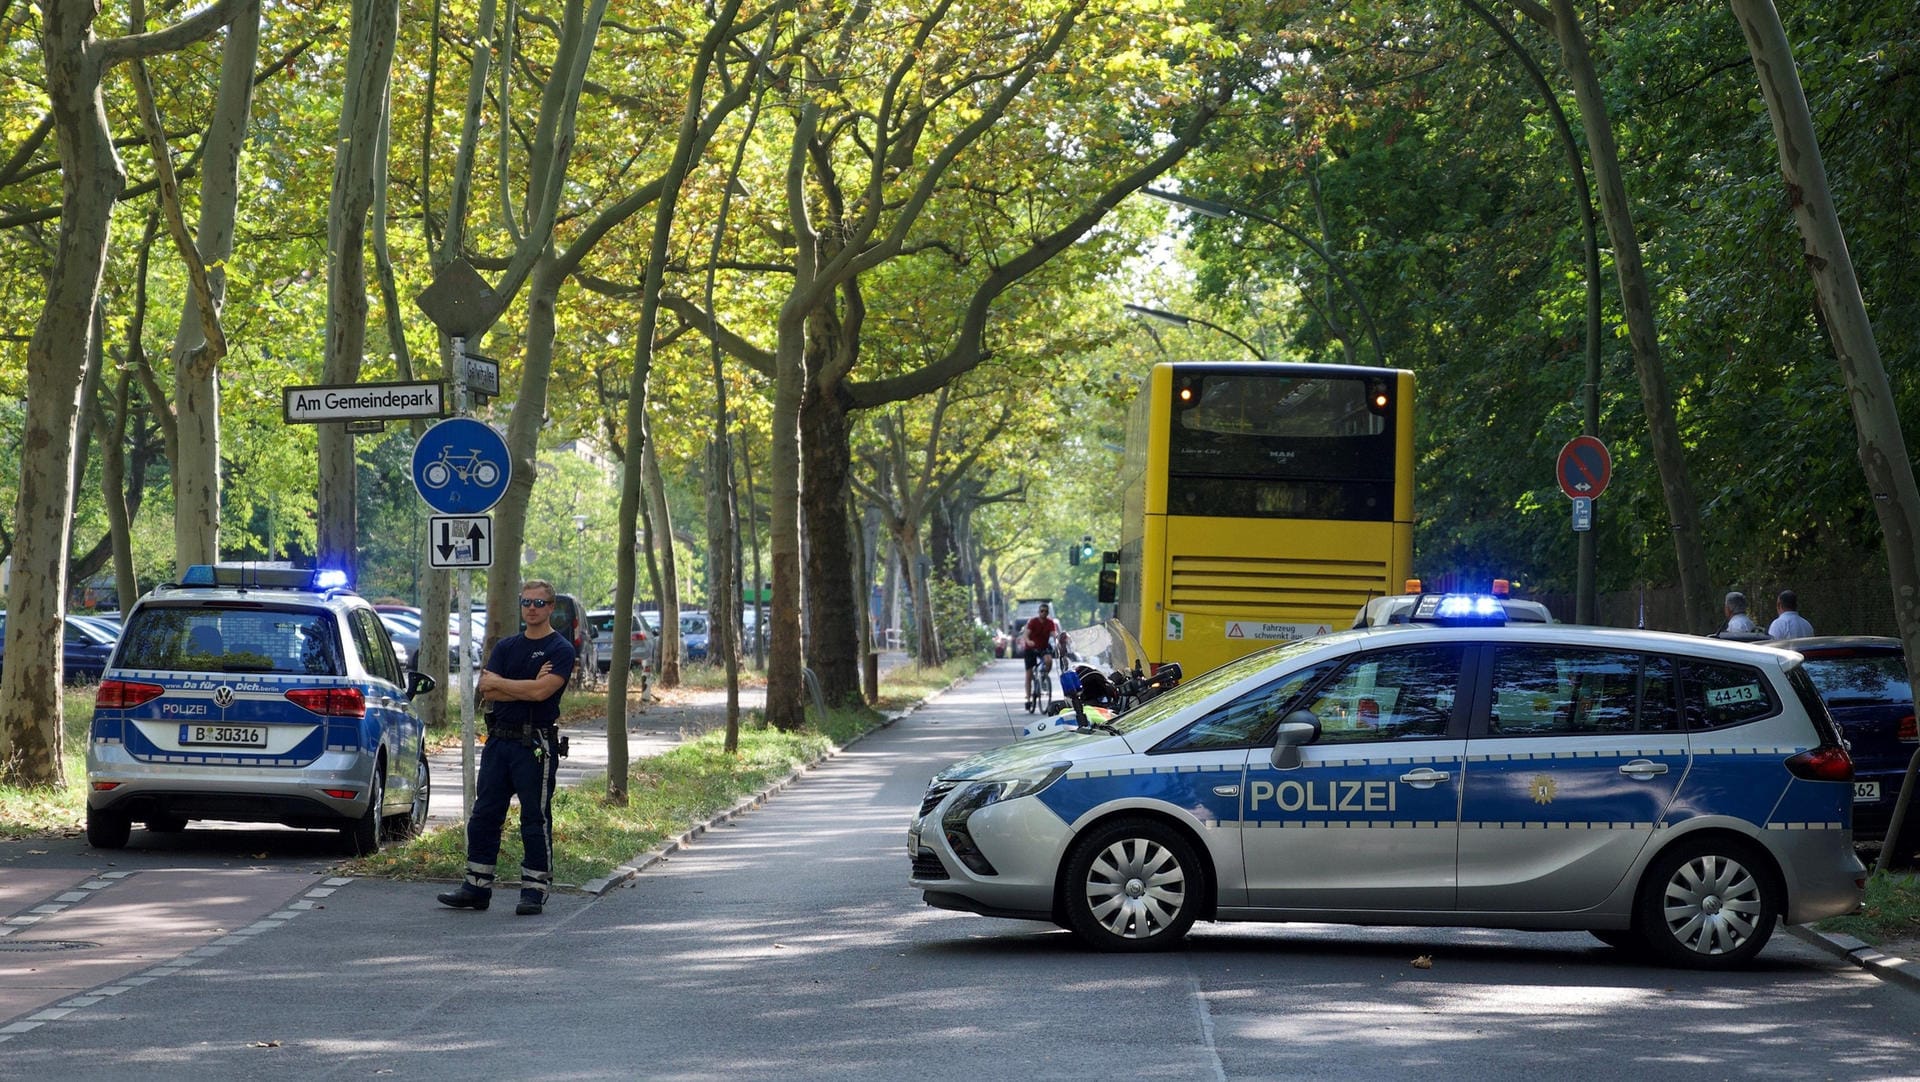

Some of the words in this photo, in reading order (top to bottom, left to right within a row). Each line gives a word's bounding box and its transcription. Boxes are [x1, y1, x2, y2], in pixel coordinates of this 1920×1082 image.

[296, 394, 321, 411] Am
[325, 389, 434, 410] Gemeindepark
[1576, 500, 1584, 514] P
[1262, 623, 1296, 633] Fahrzeug
[1254, 631, 1289, 640] schwenkt
[199, 680, 216, 690] für
[1714, 687, 1753, 703] 44-13
[162, 704, 207, 715] POLIZEI
[195, 727, 205, 741] B
[214, 728, 259, 742] 30316
[1251, 780, 1396, 812] POLIZEI
[1854, 783, 1875, 797] 62
